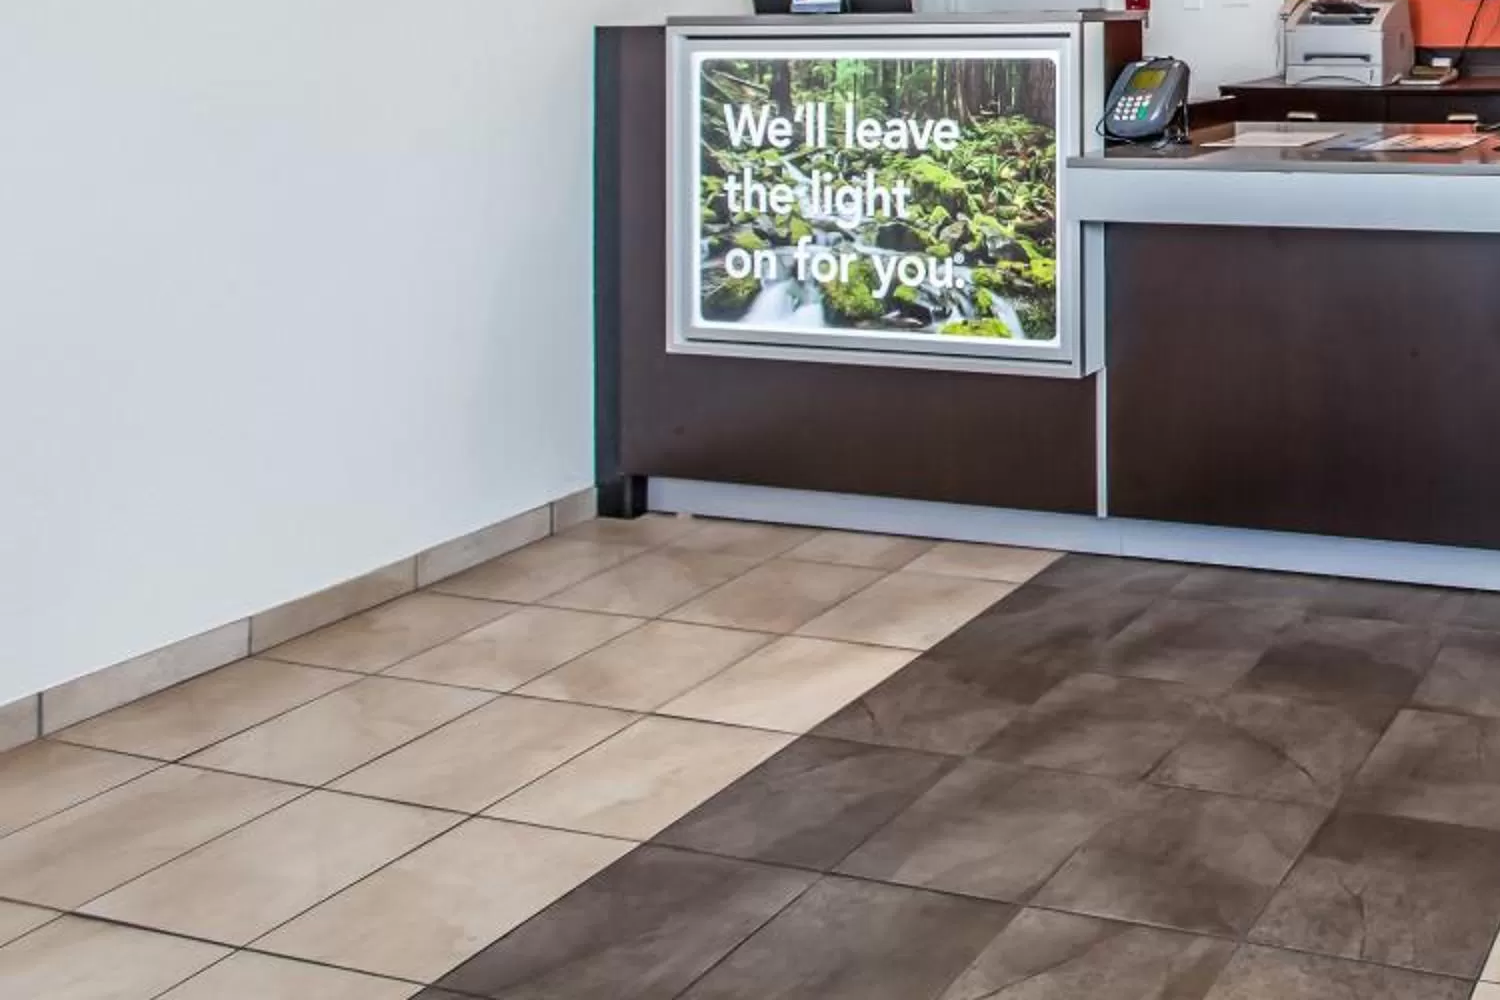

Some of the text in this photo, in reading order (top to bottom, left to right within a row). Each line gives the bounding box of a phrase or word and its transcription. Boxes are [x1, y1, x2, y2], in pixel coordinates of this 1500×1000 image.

[723, 103, 959, 151] We'll leave
[724, 168, 911, 228] the light
[725, 248, 778, 280] on
[793, 236, 858, 282] for
